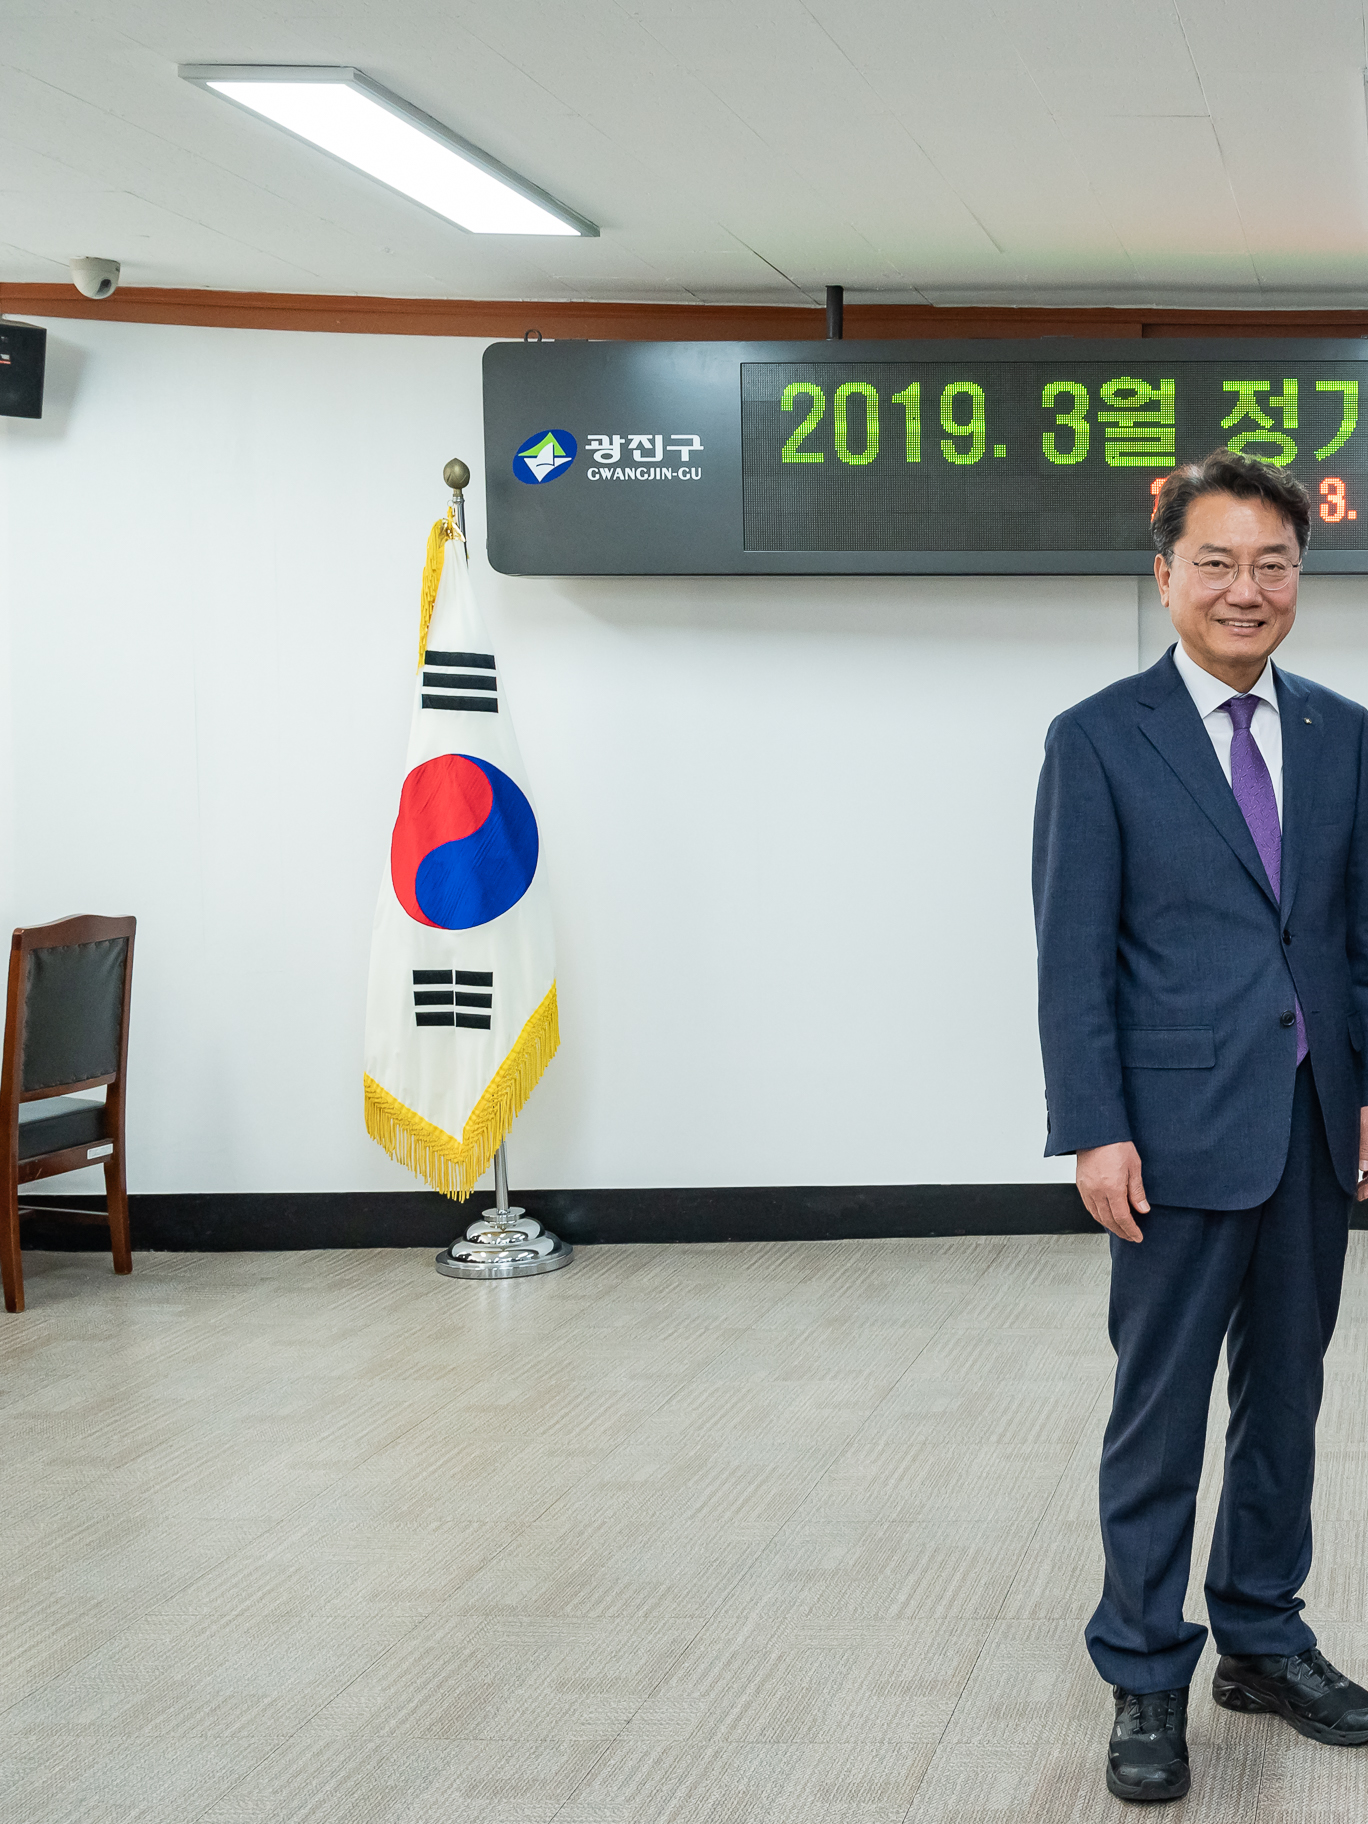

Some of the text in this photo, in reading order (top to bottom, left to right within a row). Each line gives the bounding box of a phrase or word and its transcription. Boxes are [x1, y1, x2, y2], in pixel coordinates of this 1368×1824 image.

[780, 381, 1007, 465] 2019.
[1041, 376, 1176, 467] 3월
[585, 434, 705, 464] 광진구
[587, 467, 702, 481] GWANGJIN-GU
